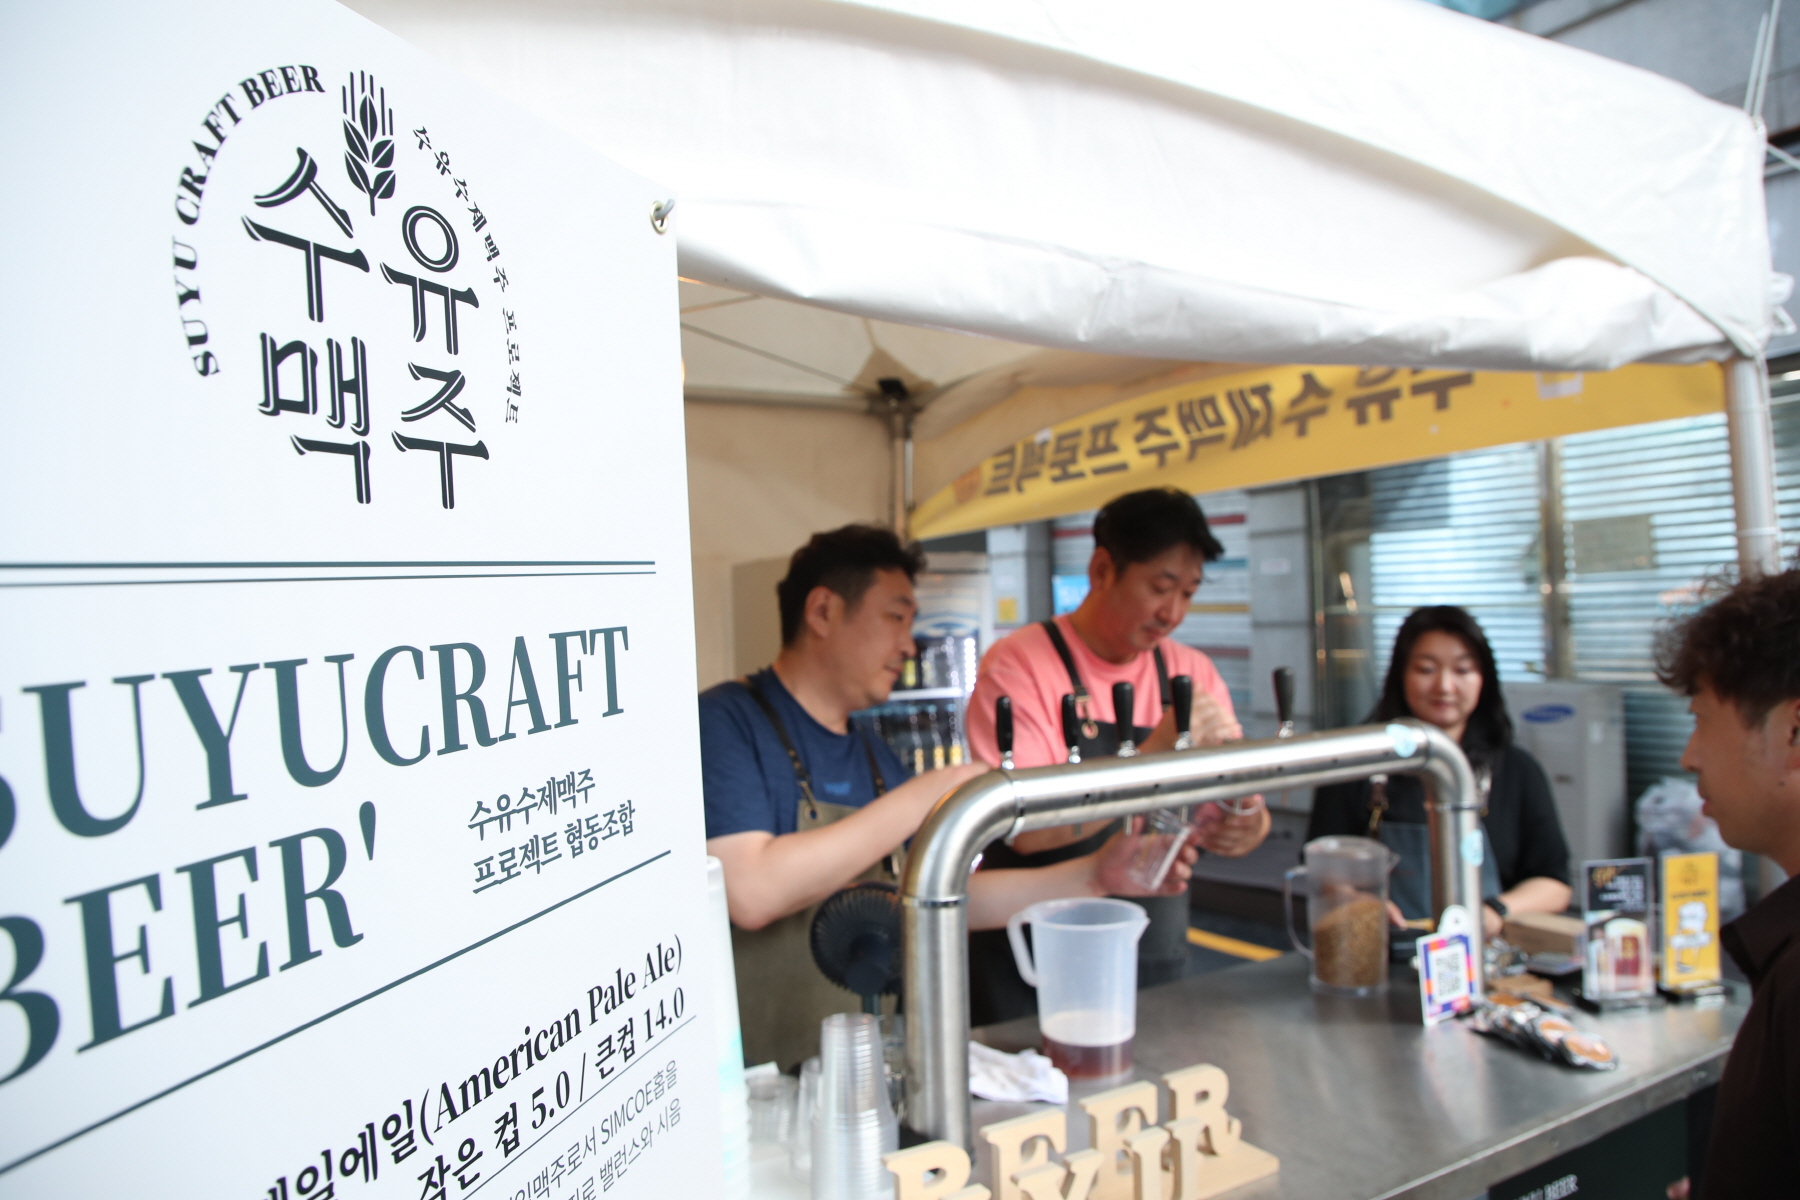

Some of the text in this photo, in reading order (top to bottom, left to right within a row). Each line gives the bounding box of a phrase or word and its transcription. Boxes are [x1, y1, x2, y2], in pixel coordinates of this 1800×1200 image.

[172, 63, 327, 378] SUYU CRAFT BEER
[241, 145, 480, 356] 수유
[412, 125, 522, 424] 수유수제맥주 프로젝트
[257, 332, 490, 510] 맥주
[0, 625, 630, 853] UYUCRAFT
[467, 768, 596, 841] 수유수제맥주
[472, 799, 636, 894] 프로젝트 협동조합
[586, 967, 637, 1026] Pale
[641, 934, 683, 990] Ale)
[494, 1101, 521, 1159] 컵
[531, 1070, 571, 1130] 5.0
[594, 1017, 636, 1080] 큰컵
[643, 986, 686, 1043] 14.0
[600, 1059, 678, 1146] SIMCOE홉을
[600, 1120, 654, 1193] 밸런스와
[657, 1097, 681, 1136] 시음
